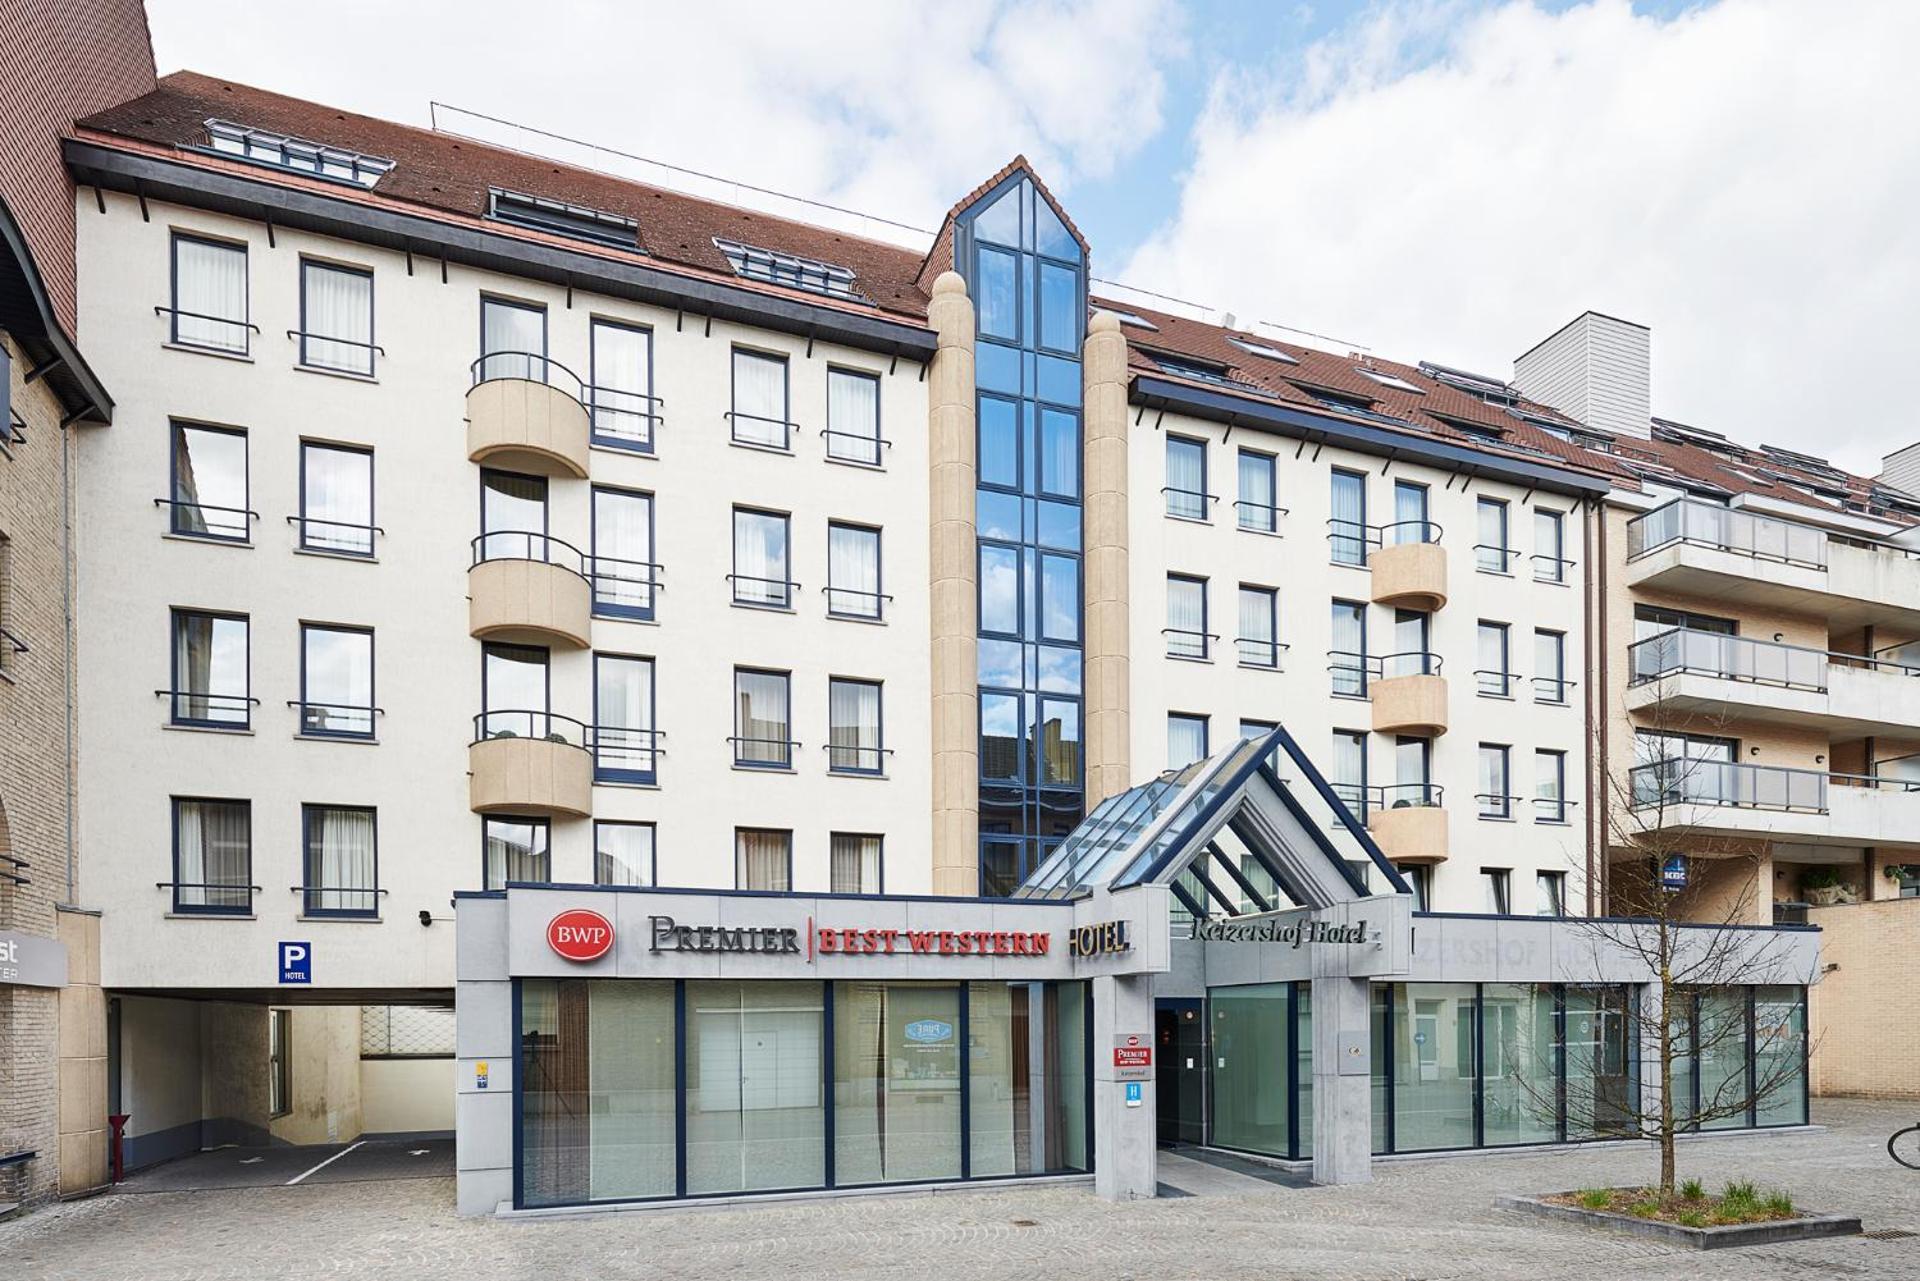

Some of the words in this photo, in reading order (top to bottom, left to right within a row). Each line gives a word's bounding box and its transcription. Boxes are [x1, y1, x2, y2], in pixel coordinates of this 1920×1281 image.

[557, 926, 606, 944] BWP
[647, 915, 800, 954] PREMIER
[818, 928, 898, 955] BEST
[905, 930, 1051, 957] WESTERN
[1068, 919, 1130, 953] HOTEL
[1190, 918, 1309, 950] Keizershof
[1310, 920, 1367, 944] Hotel
[284, 945, 306, 969] P
[284, 972, 307, 980] HOTEL
